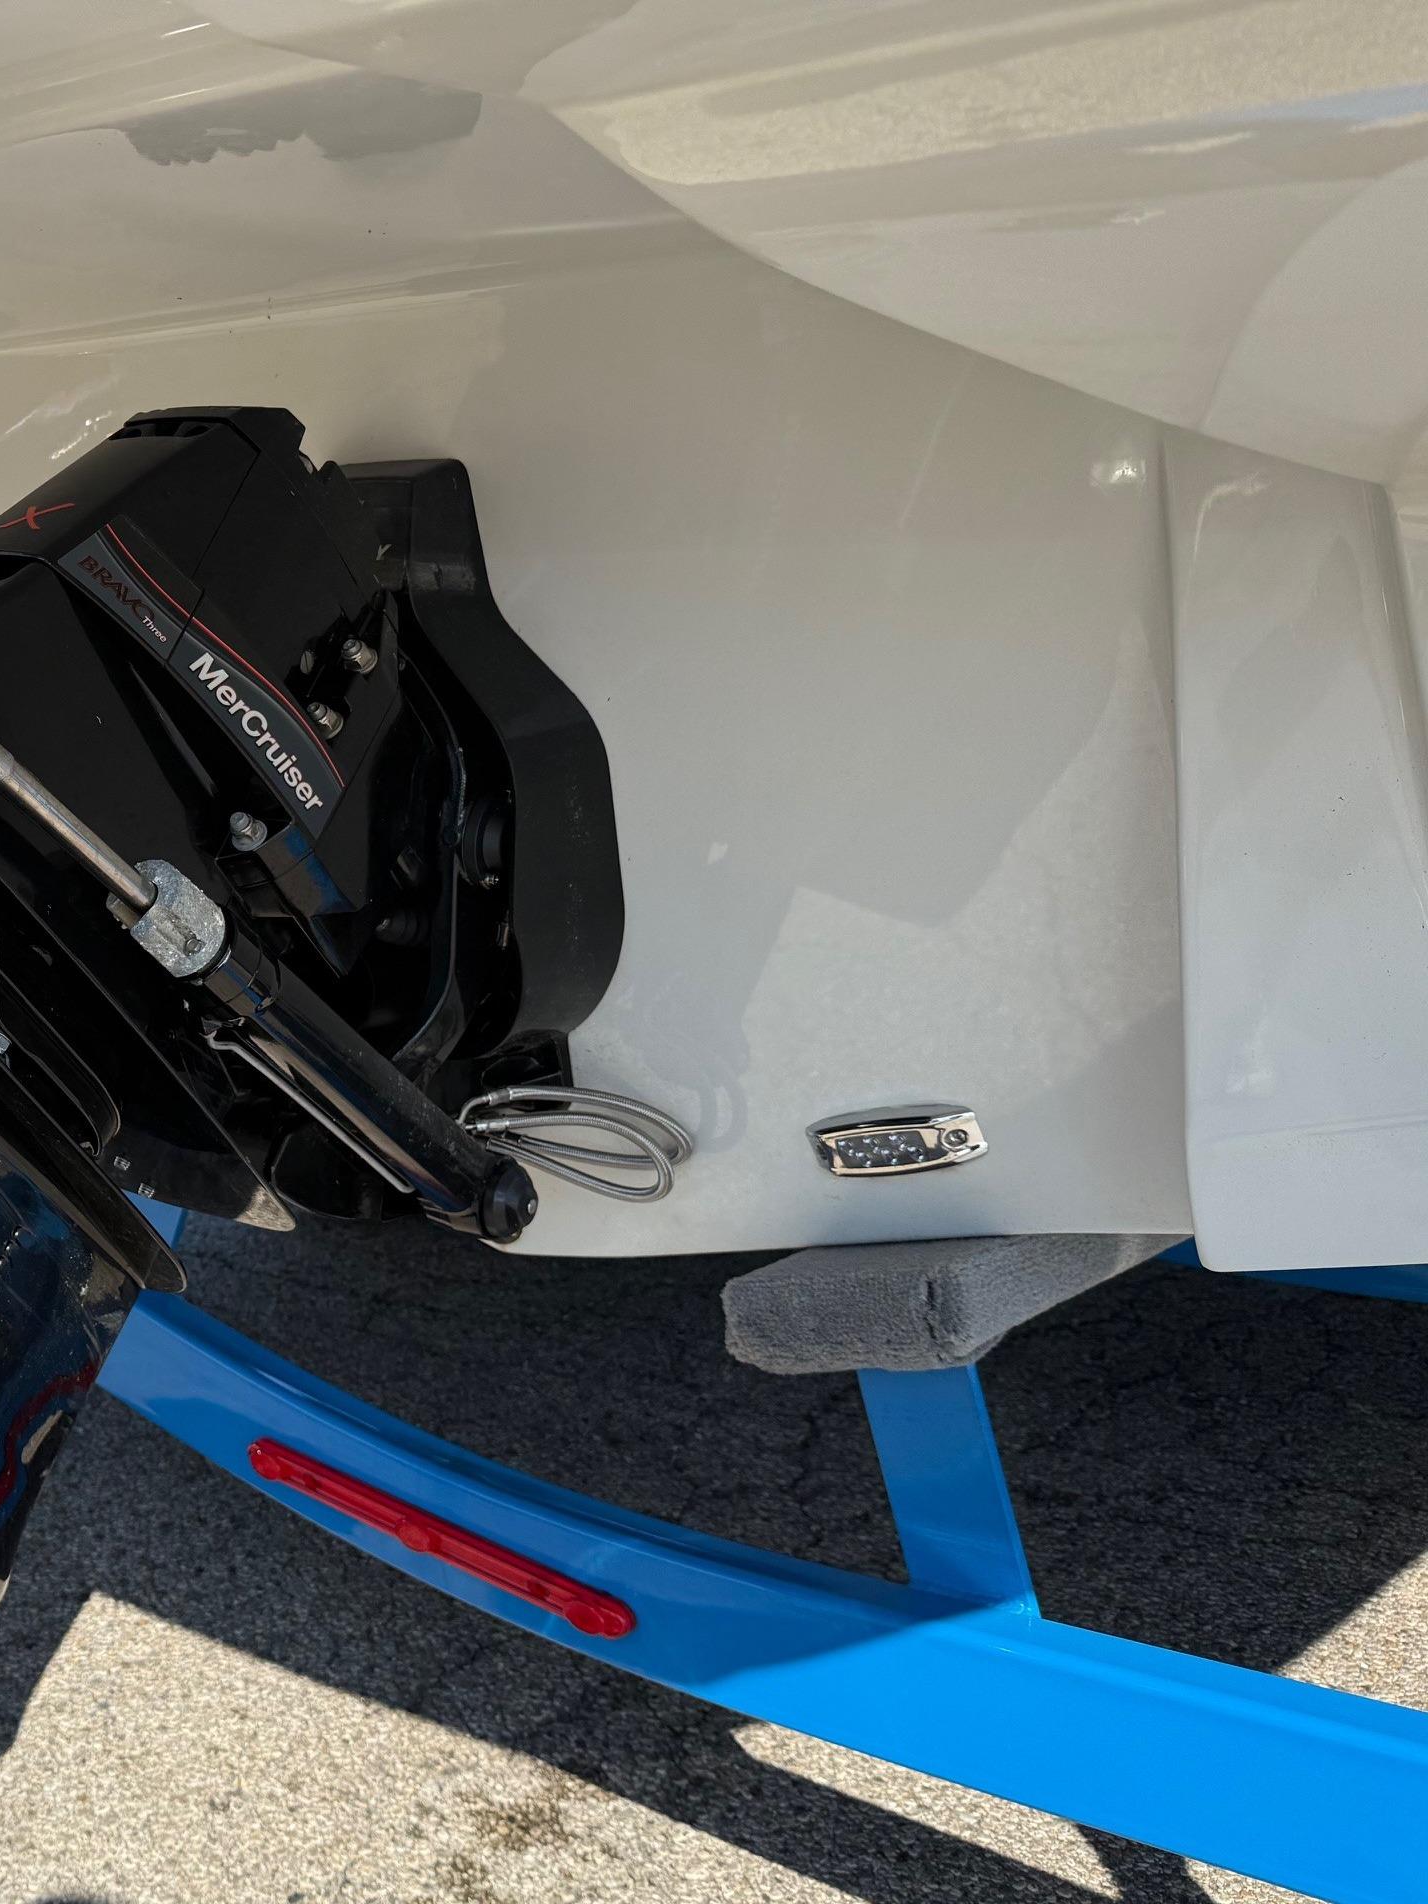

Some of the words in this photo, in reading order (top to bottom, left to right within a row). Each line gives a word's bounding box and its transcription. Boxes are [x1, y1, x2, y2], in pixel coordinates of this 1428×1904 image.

[78, 554, 156, 622] BRAVO
[141, 615, 168, 643] Three
[188, 651, 324, 811] MerCruiser
